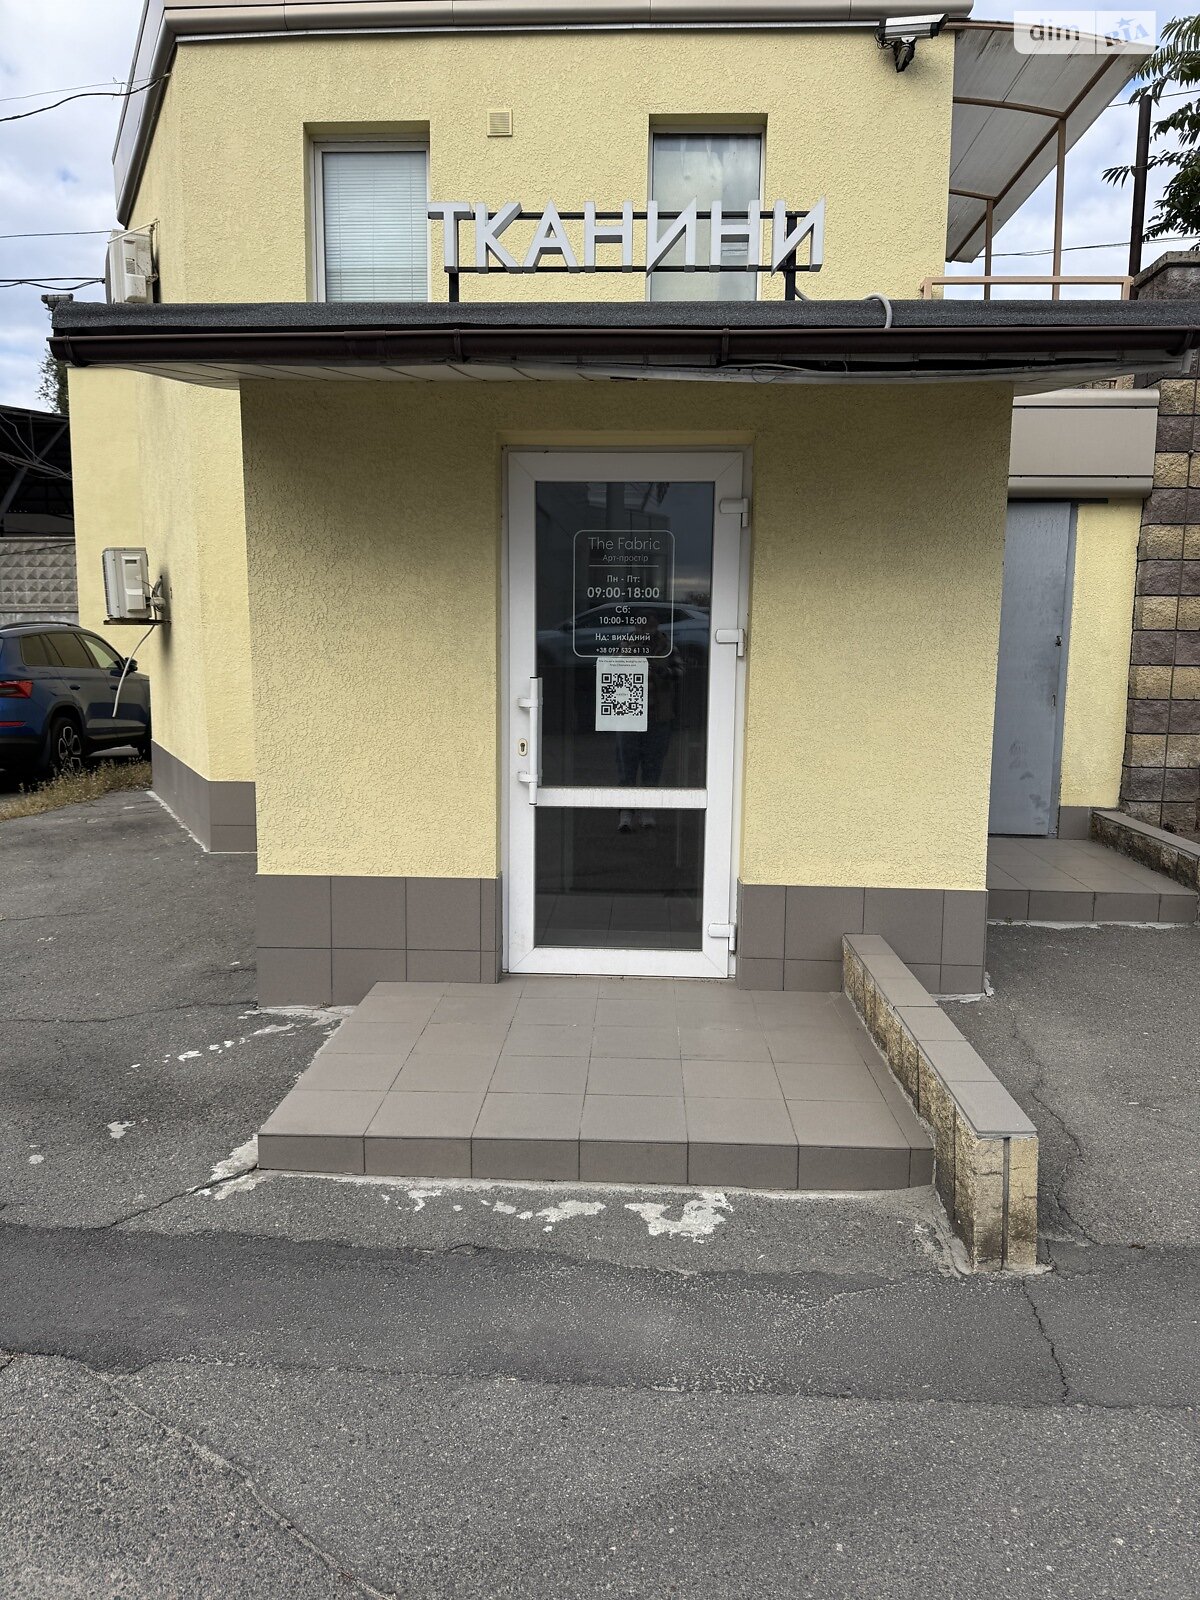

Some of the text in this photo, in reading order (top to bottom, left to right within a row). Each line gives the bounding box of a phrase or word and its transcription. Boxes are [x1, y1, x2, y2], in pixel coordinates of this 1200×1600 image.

[427, 198, 825, 276] ТКАНИНИ
[588, 537, 661, 550] The Fabric
[602, 554, 649, 563] Арт-простір
[606, 575, 618, 583] Пн
[627, 575, 641, 583] Пт:
[587, 587, 660, 598] 09:00-18:00
[615, 605, 631, 614] Сб:
[599, 616, 647, 625] 10:00-15:00
[595, 632, 651, 642] Нд: вихідний
